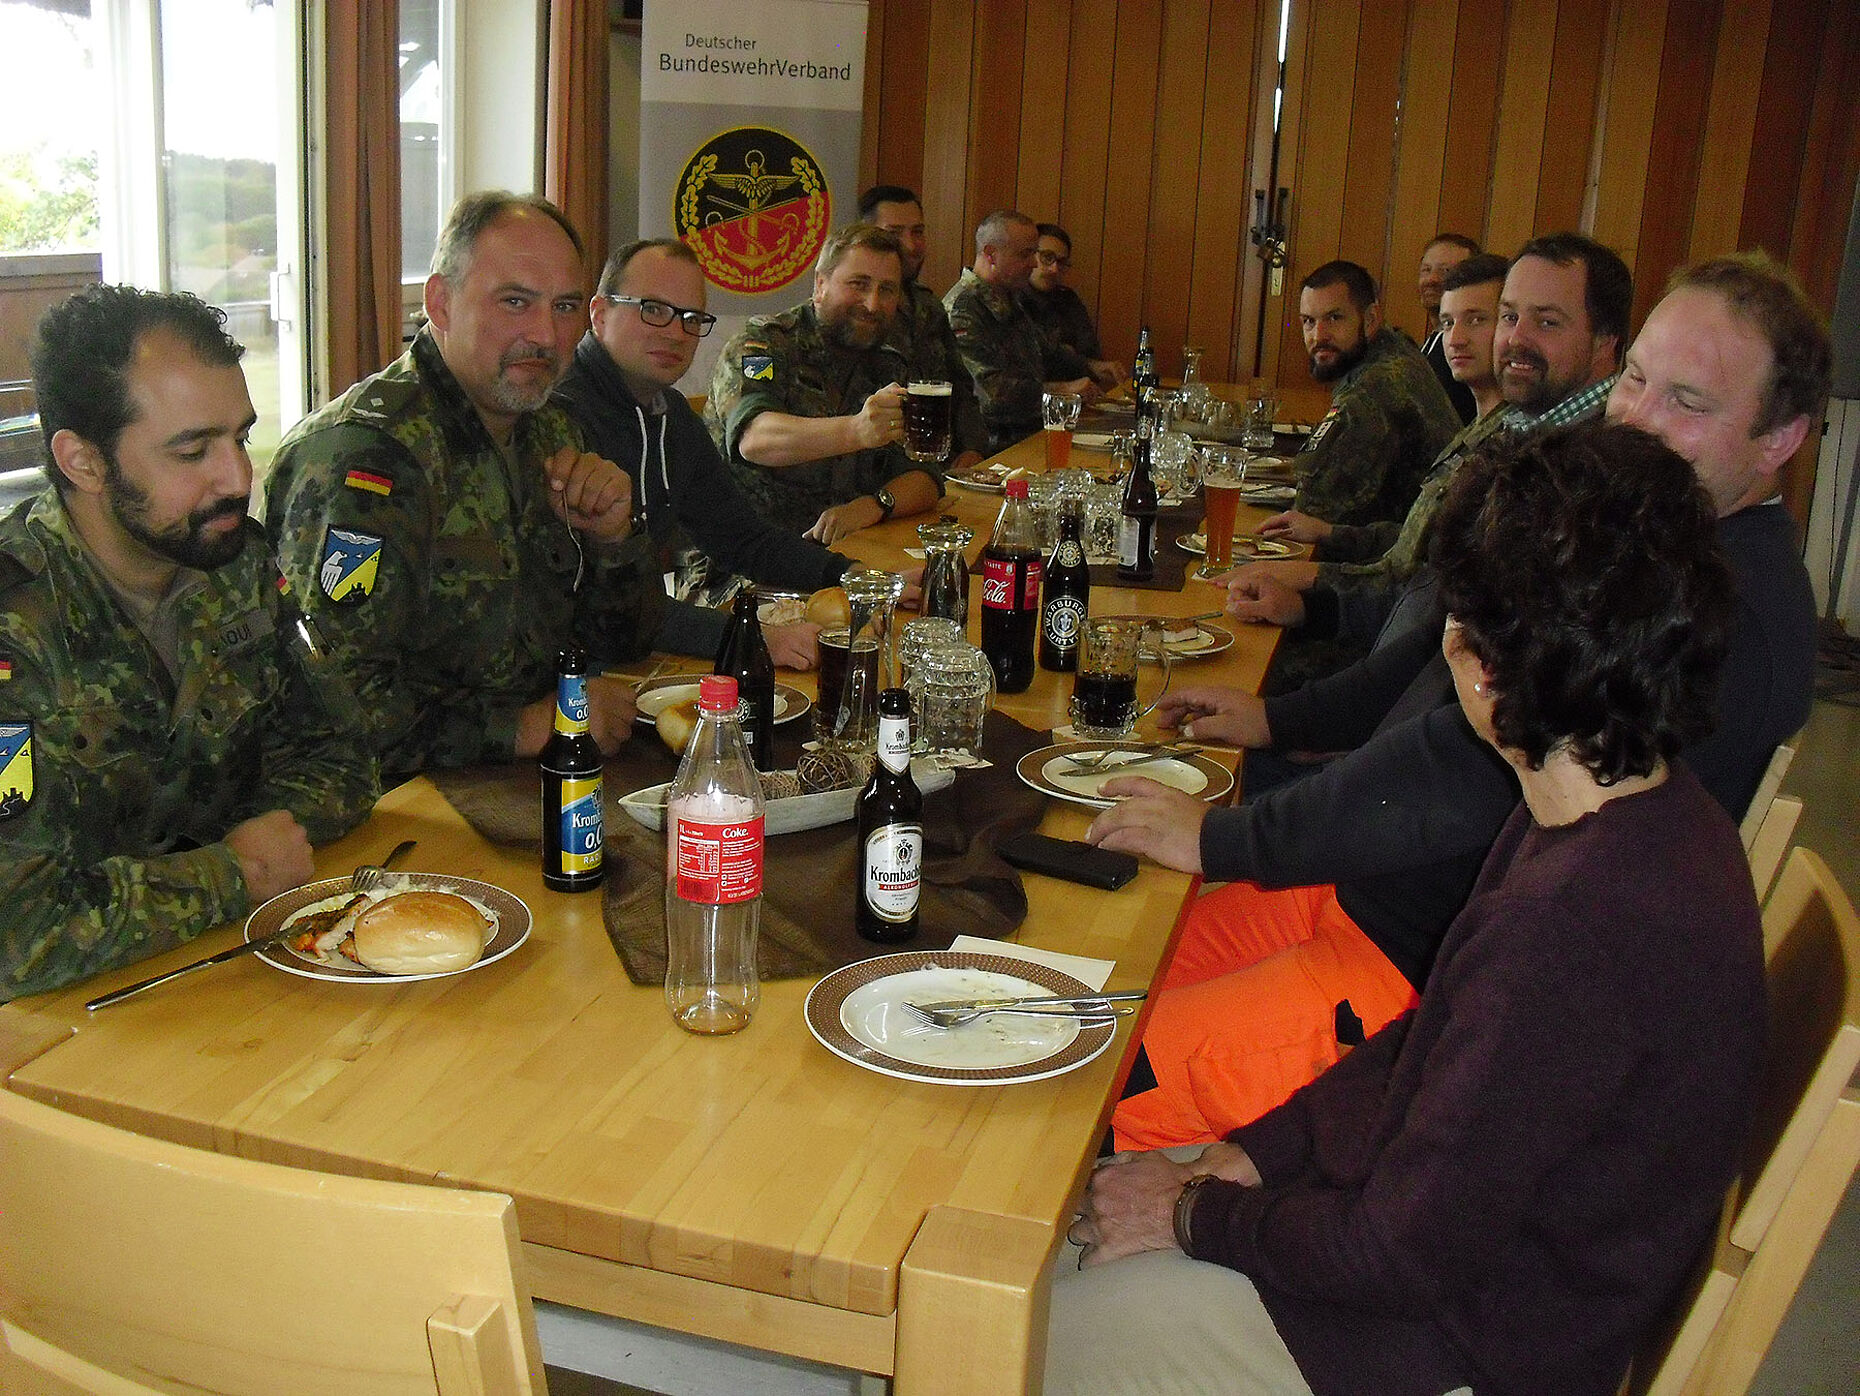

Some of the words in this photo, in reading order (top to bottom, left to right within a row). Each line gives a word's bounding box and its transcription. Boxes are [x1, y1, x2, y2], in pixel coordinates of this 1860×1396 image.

[685, 33, 757, 50] Deutscher
[659, 53, 851, 81] BundeswehrVerband
[1045, 599, 1085, 627] WARBURGE
